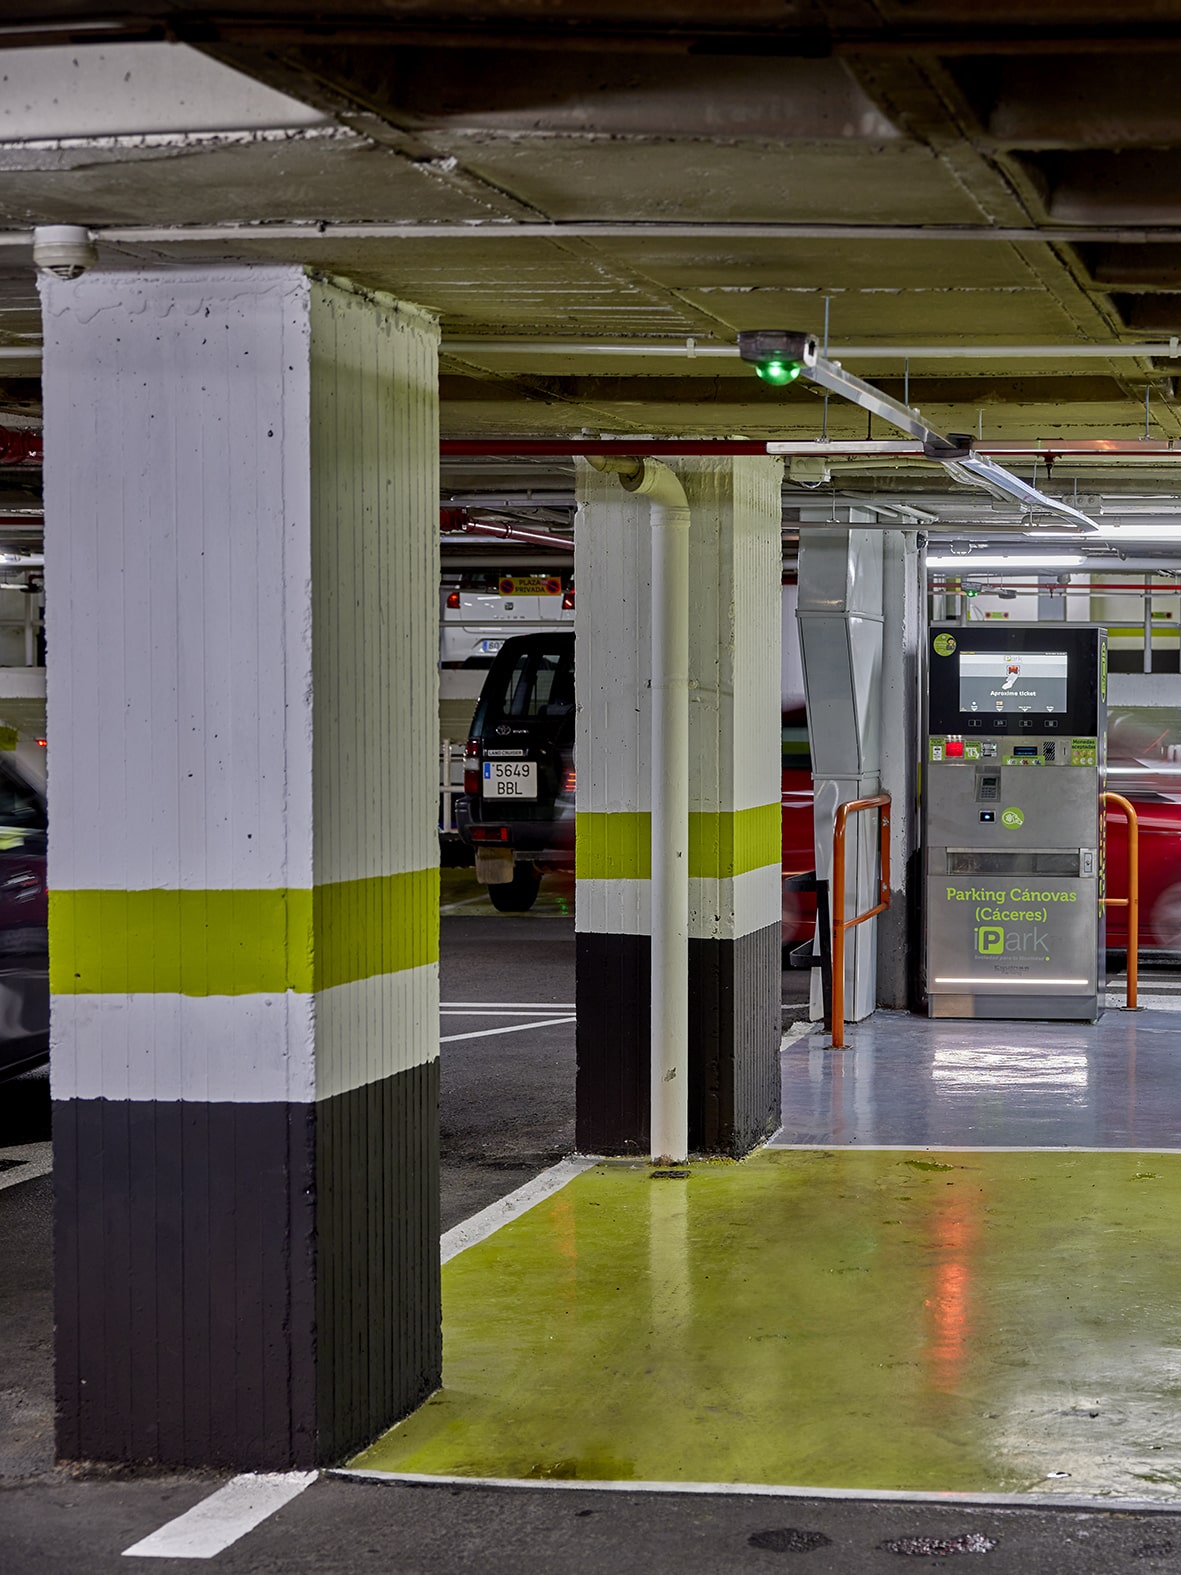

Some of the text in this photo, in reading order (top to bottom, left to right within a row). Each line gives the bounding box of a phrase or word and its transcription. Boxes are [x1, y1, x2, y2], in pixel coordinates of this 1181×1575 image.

[495, 764, 530, 778] 5649
[497, 781, 523, 796] BBL
[946, 887, 1078, 905] Parking Cánovas
[975, 907, 1048, 923] (Cáceres)
[973, 926, 1049, 955] iPark
